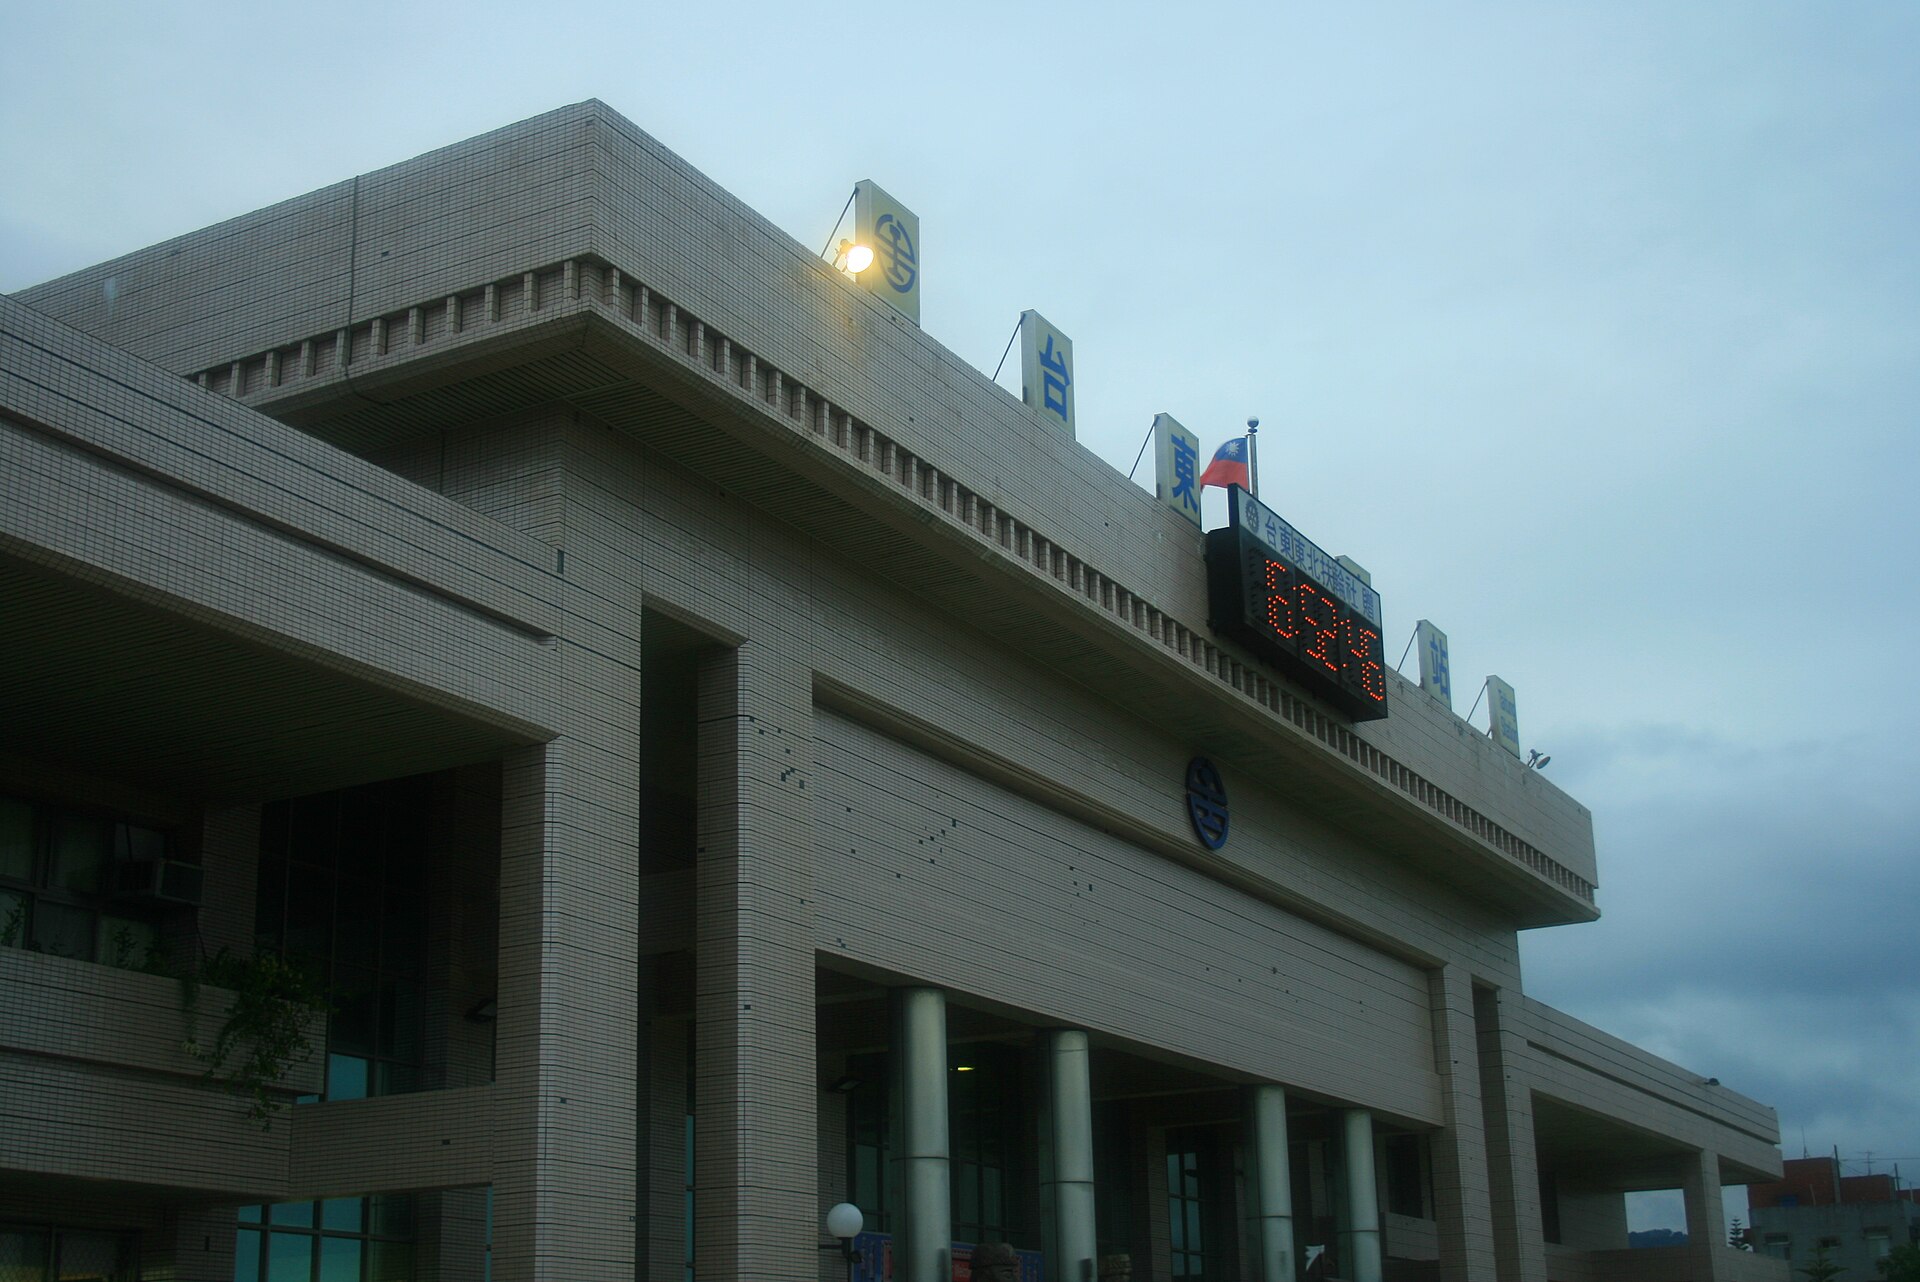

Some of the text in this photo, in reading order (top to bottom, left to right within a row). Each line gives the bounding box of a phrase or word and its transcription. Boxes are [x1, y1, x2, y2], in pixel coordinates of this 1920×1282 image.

[1038, 333, 1450, 700] 台 東 站
